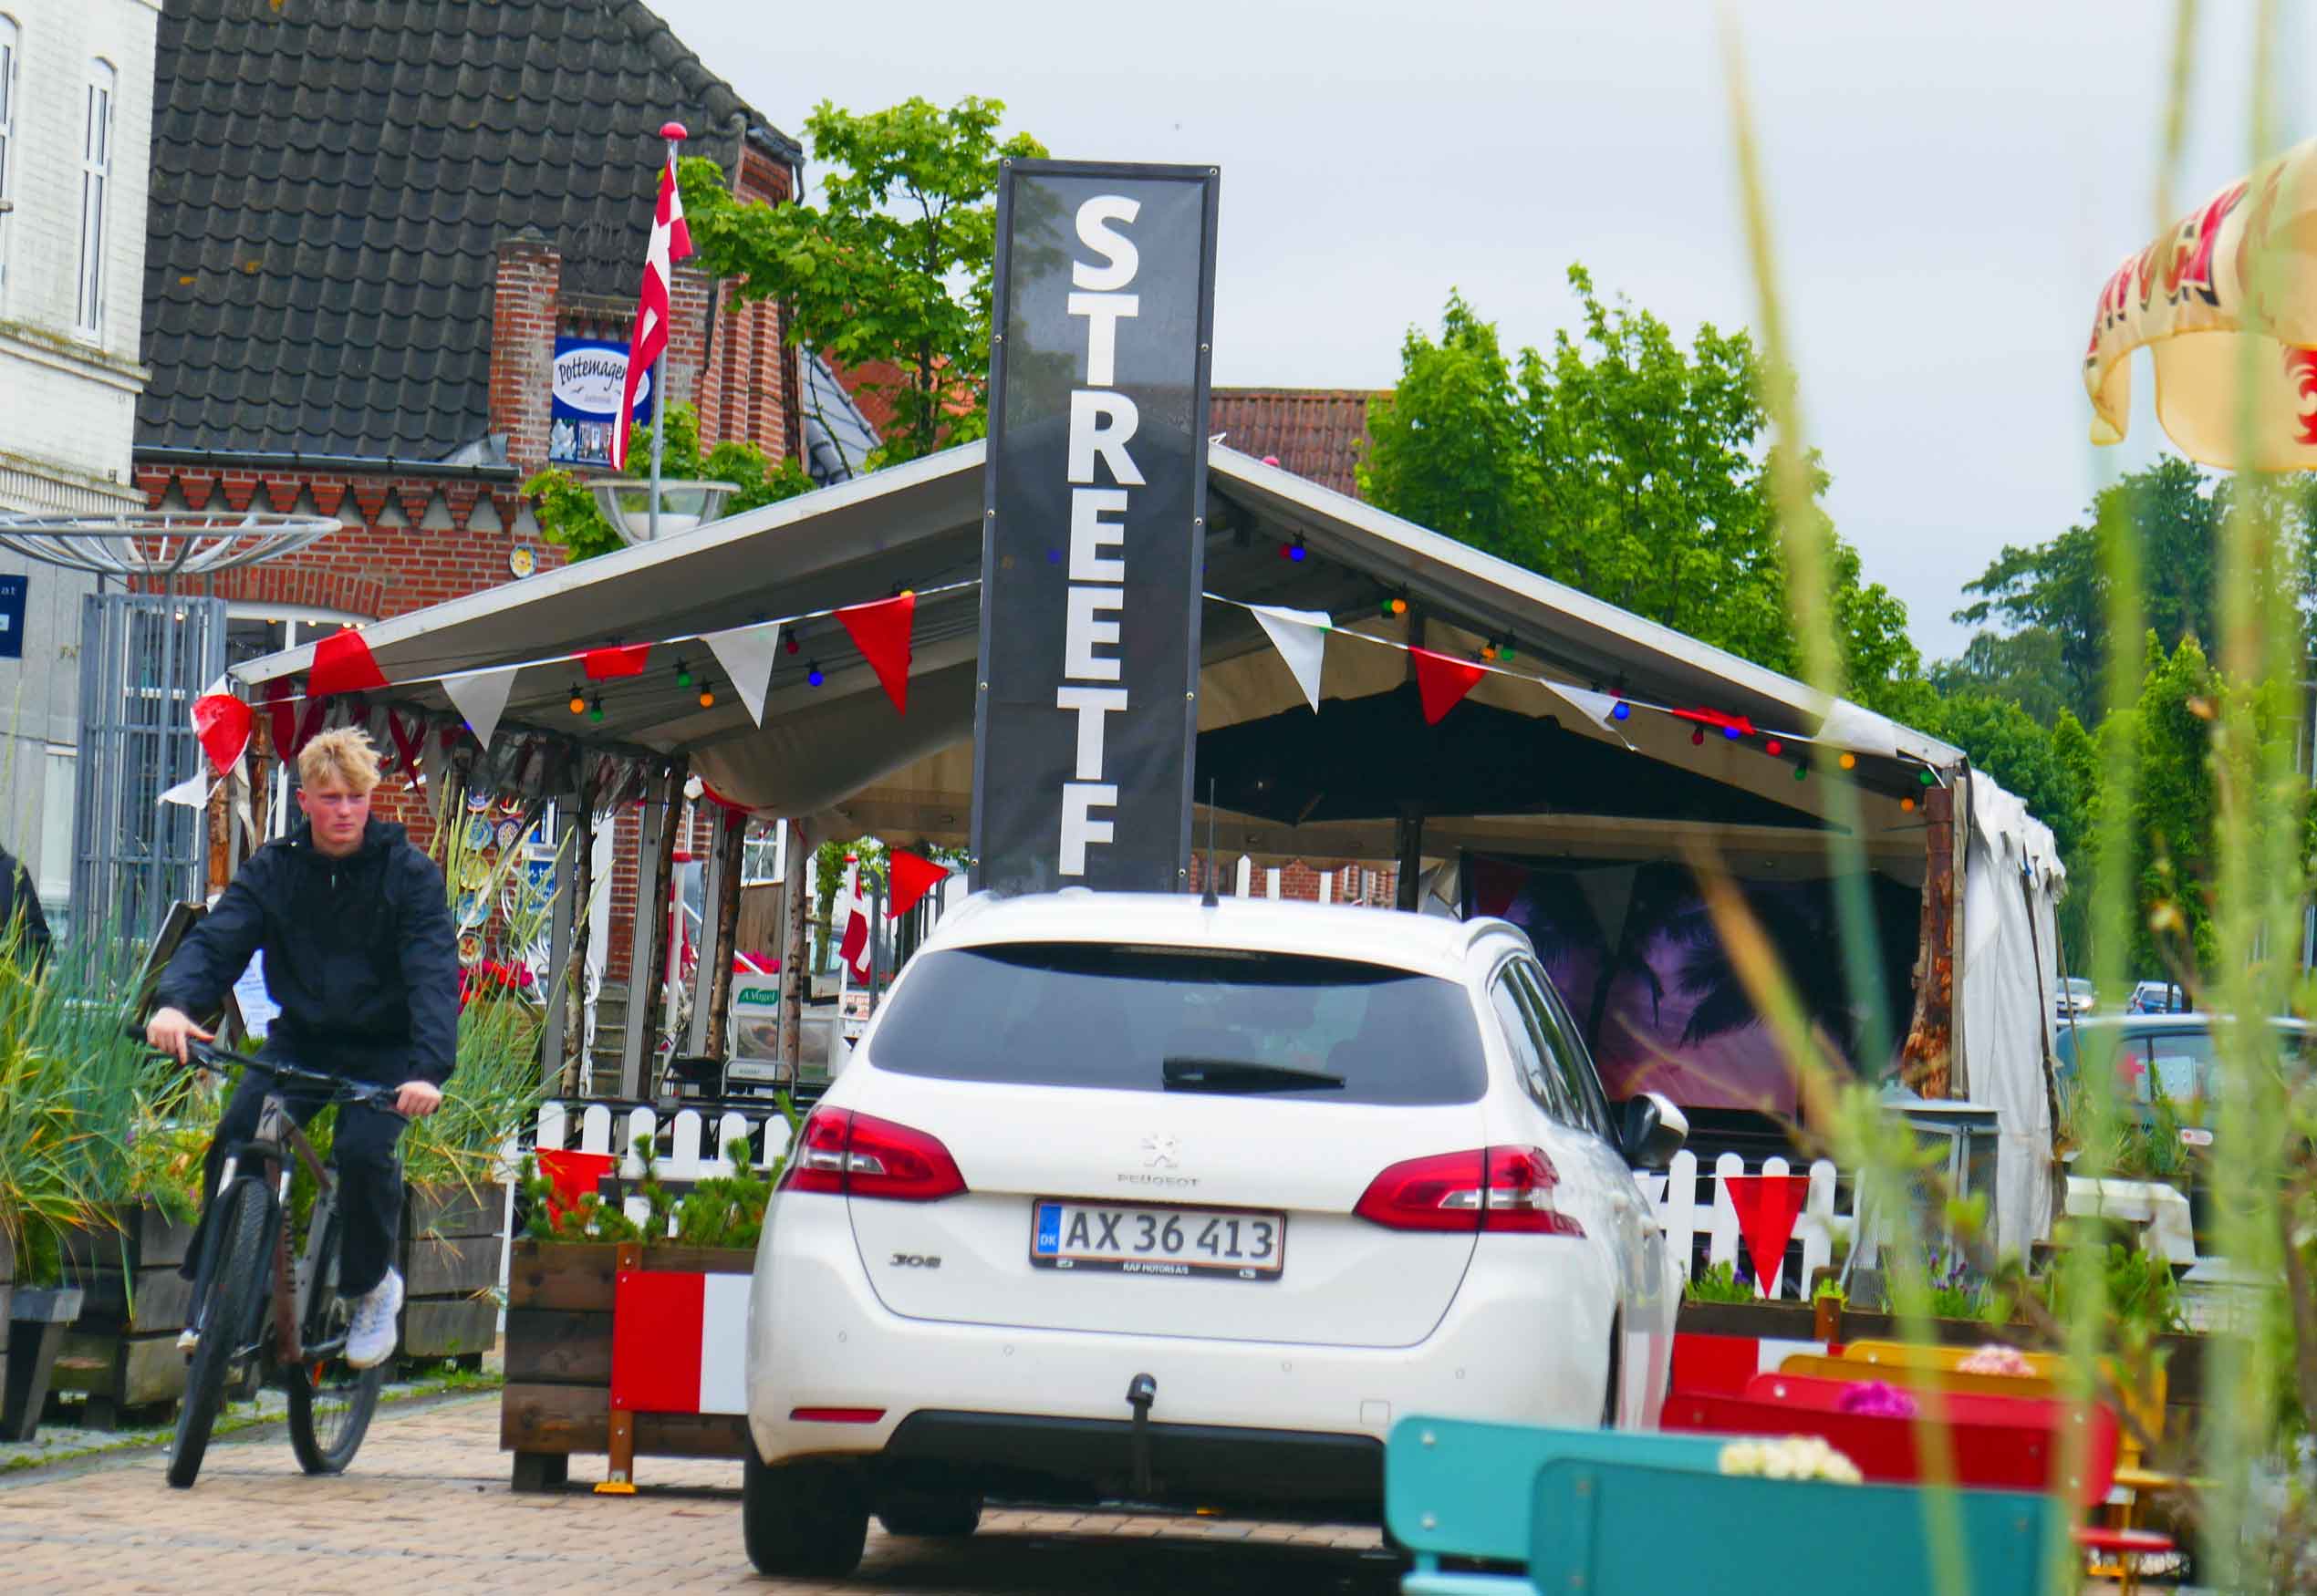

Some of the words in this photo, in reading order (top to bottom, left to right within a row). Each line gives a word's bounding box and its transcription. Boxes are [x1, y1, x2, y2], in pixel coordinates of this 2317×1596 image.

[1056, 193, 1147, 876] STREETF
[1117, 1173, 1201, 1187] PEUGEOT
[1039, 1234, 1056, 1247] DK
[1065, 1212, 1123, 1250] AX
[1133, 1215, 1184, 1254] 36
[1196, 1218, 1273, 1259] 413
